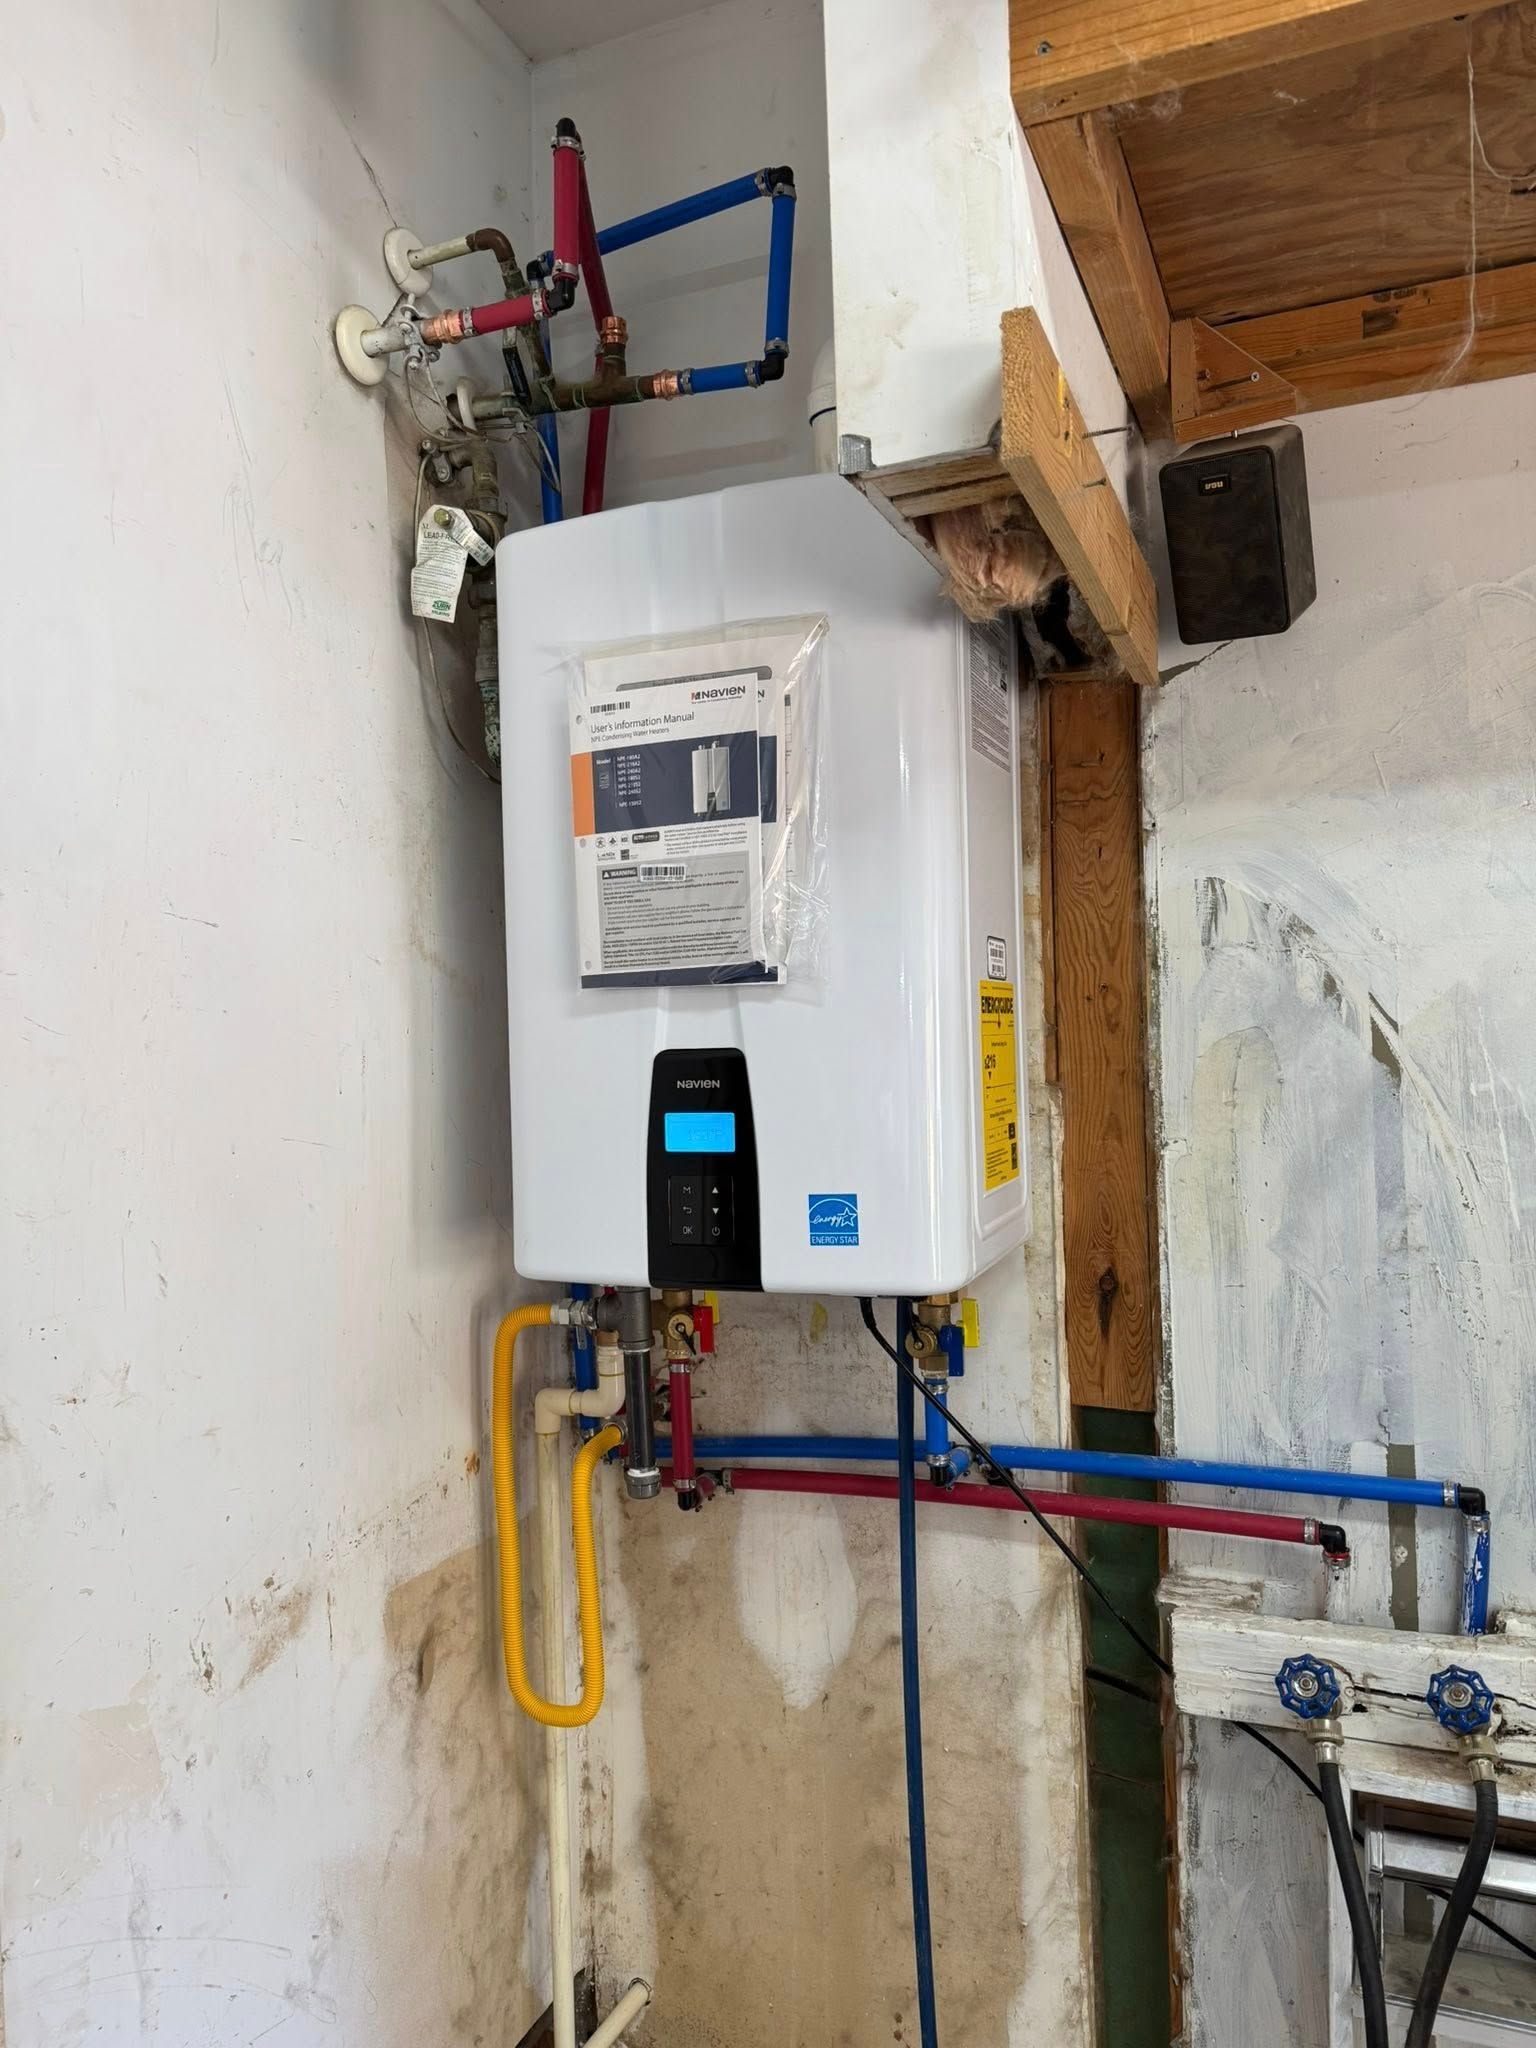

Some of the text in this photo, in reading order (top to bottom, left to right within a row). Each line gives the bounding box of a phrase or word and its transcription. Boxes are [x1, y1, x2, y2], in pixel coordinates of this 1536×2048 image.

[590, 711, 695, 734] User's Information Manual
[683, 1226, 693, 1235] OK
[811, 1236, 858, 1244] ENERGY STAR
